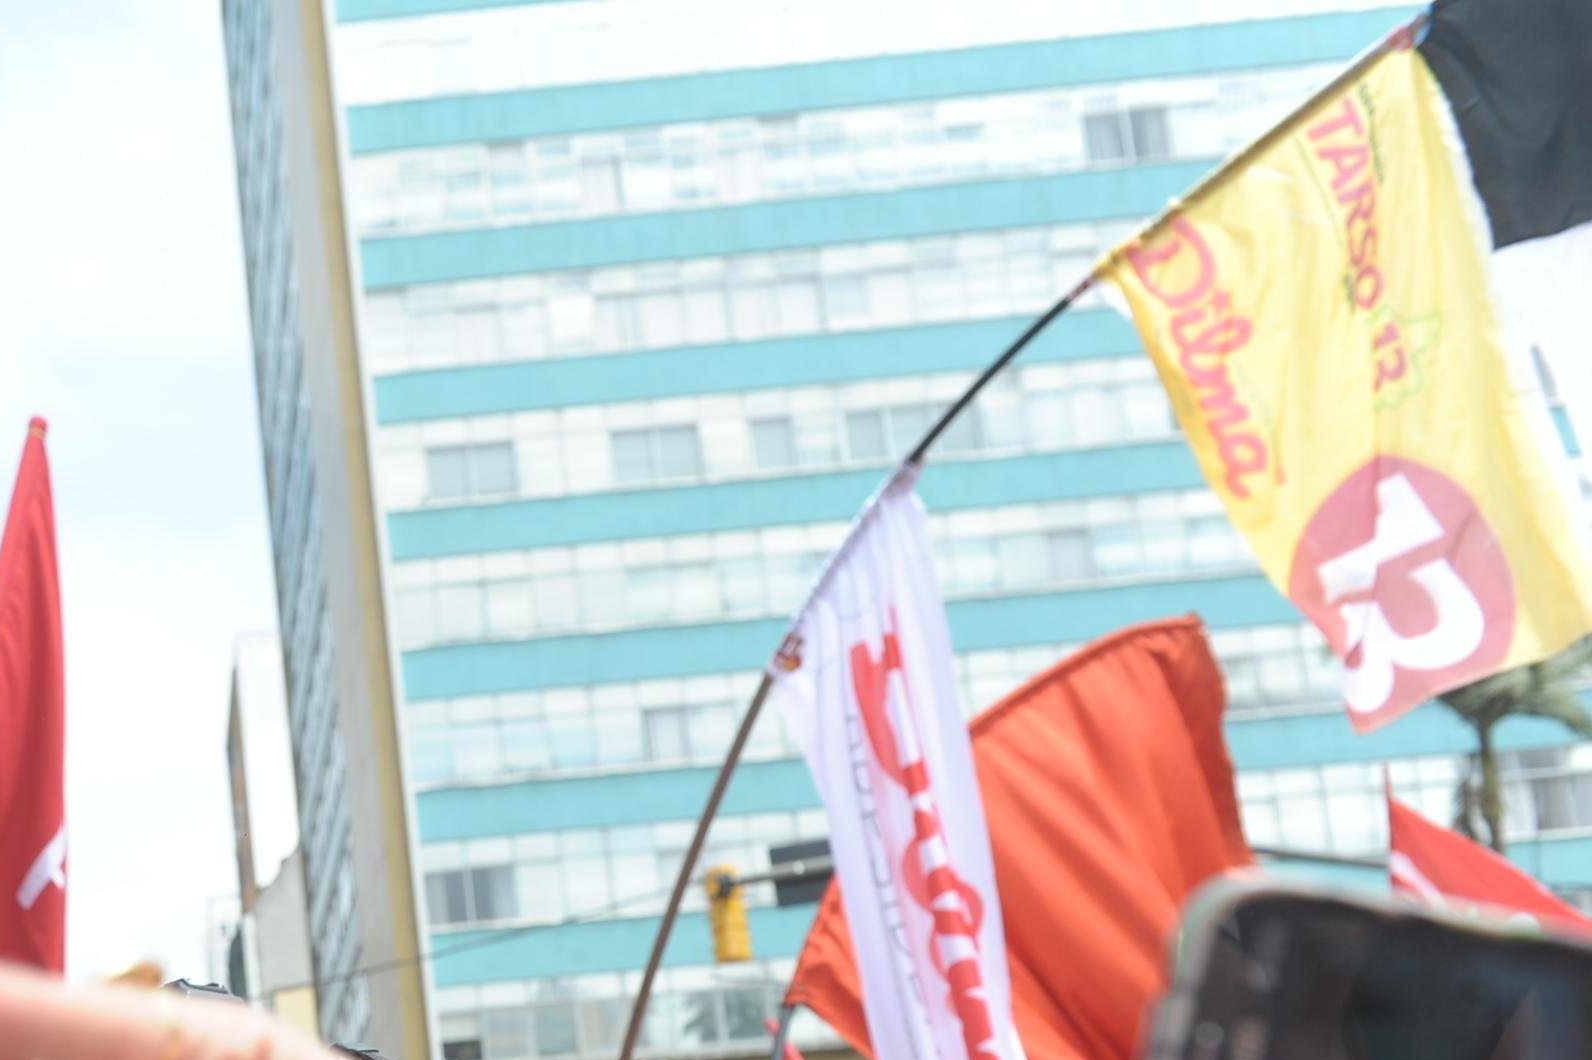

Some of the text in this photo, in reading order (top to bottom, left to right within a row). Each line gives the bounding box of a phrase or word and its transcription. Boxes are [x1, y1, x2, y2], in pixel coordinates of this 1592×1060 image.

[1307, 97, 1384, 312] TARSO
[1126, 218, 1268, 500] Dilma
[1319, 474, 1484, 713] 13
